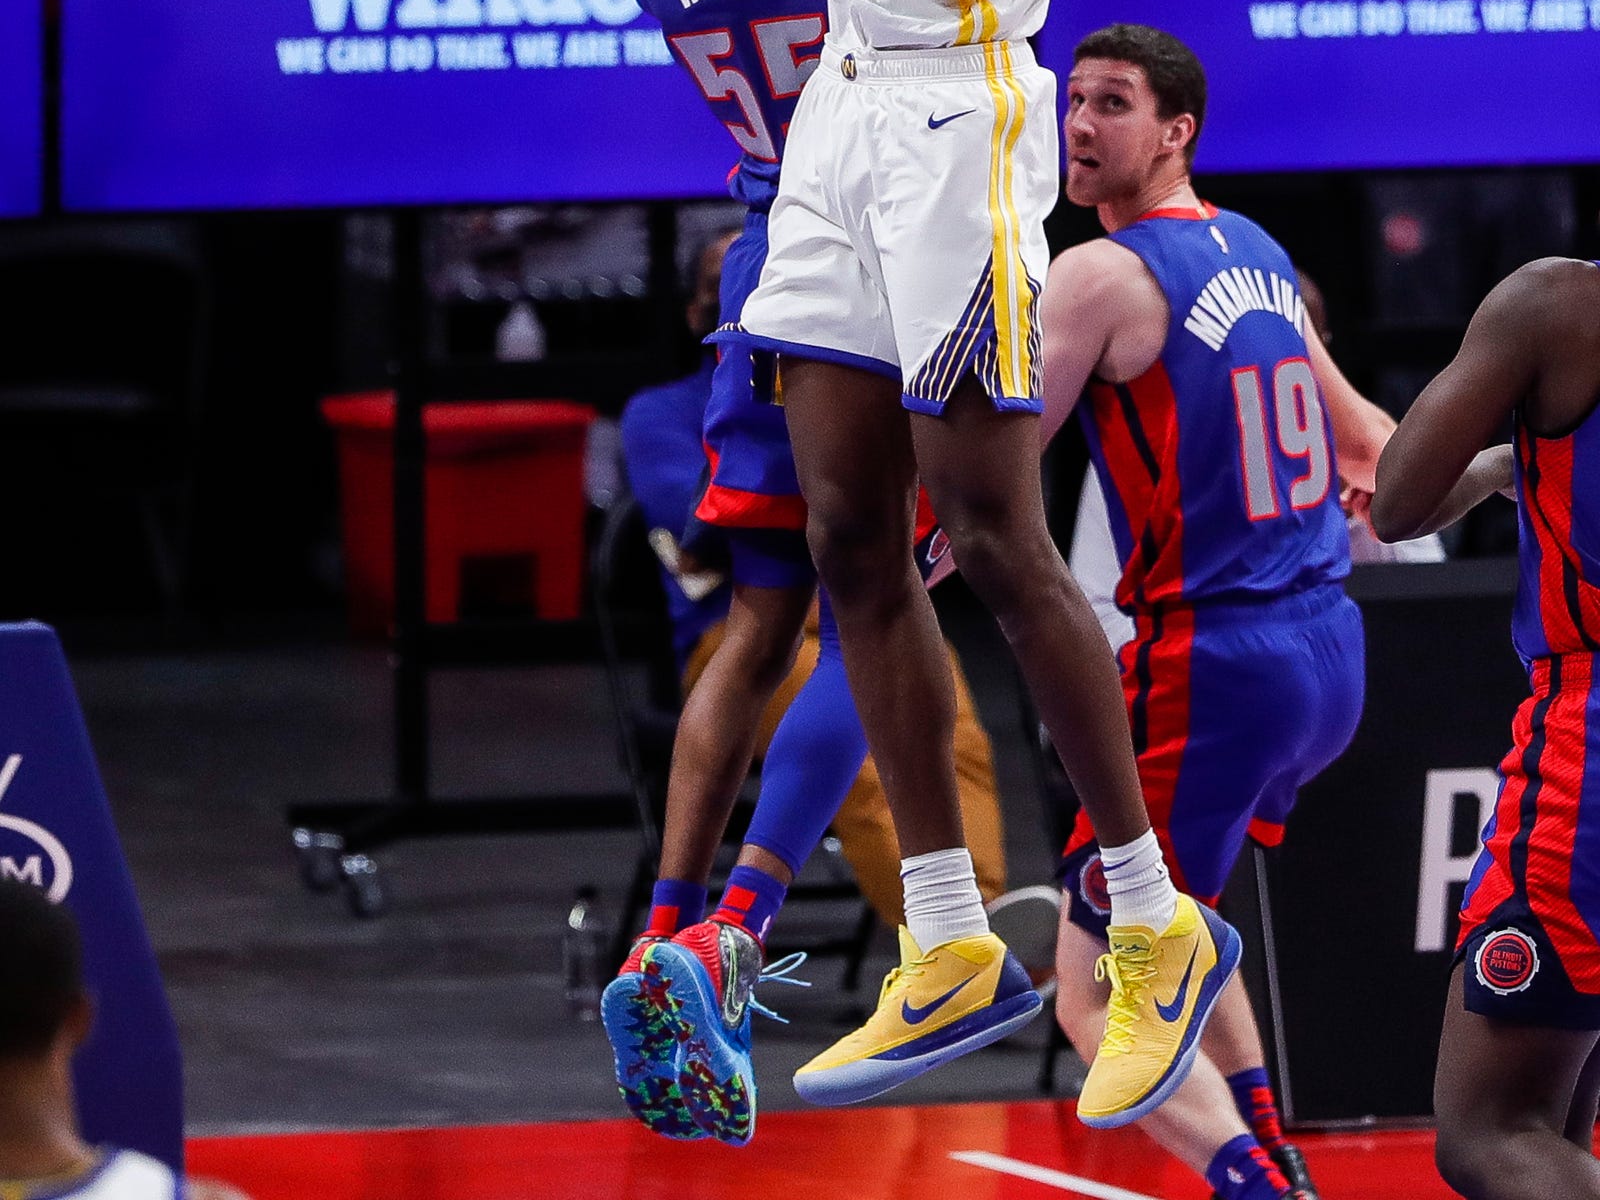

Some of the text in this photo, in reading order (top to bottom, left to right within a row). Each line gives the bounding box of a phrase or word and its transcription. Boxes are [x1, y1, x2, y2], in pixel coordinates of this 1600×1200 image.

[275, 36, 325, 75] WE
[512, 30, 560, 68] WE
[1249, 1, 1297, 39] WE
[667, 13, 830, 164] 55
[1230, 355, 1331, 522] 19
